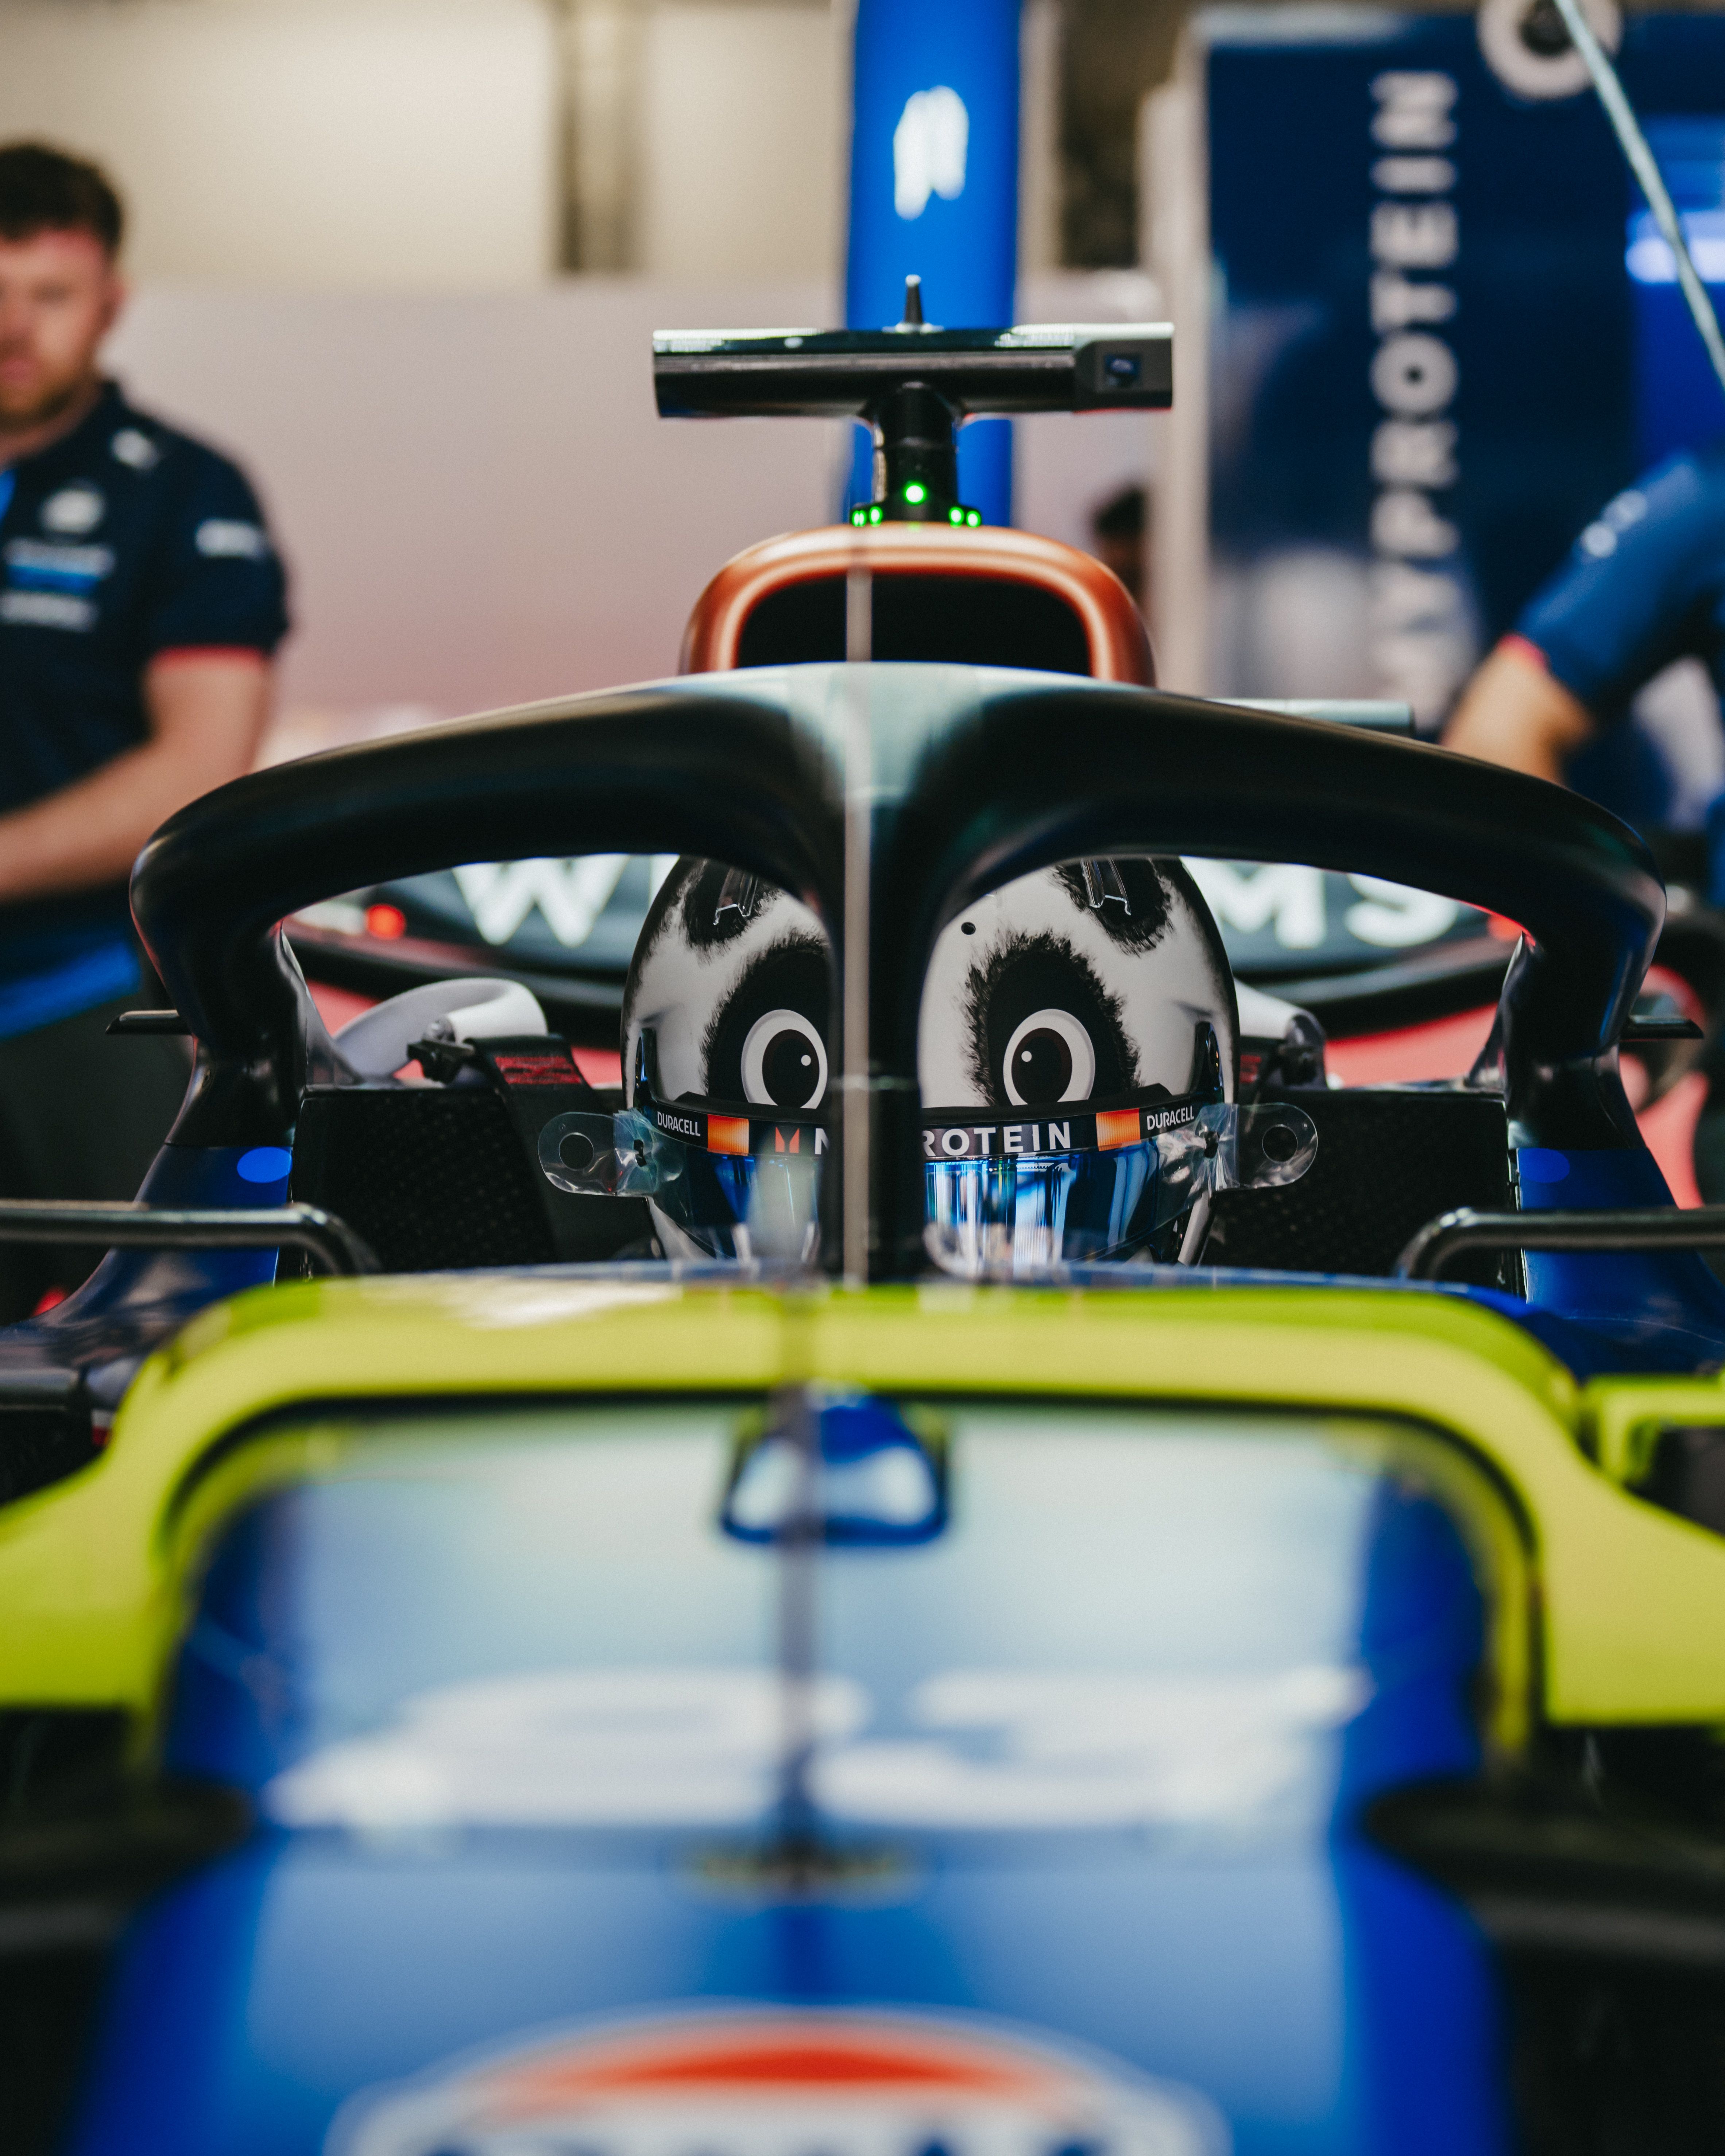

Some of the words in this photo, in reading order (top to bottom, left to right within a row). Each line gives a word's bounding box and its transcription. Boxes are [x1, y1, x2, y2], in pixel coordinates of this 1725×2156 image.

[657, 1111, 701, 1137] DURACELL
[1147, 1105, 1194, 1131] DURACELL
[814, 1121, 1071, 1157] ROTEIN
